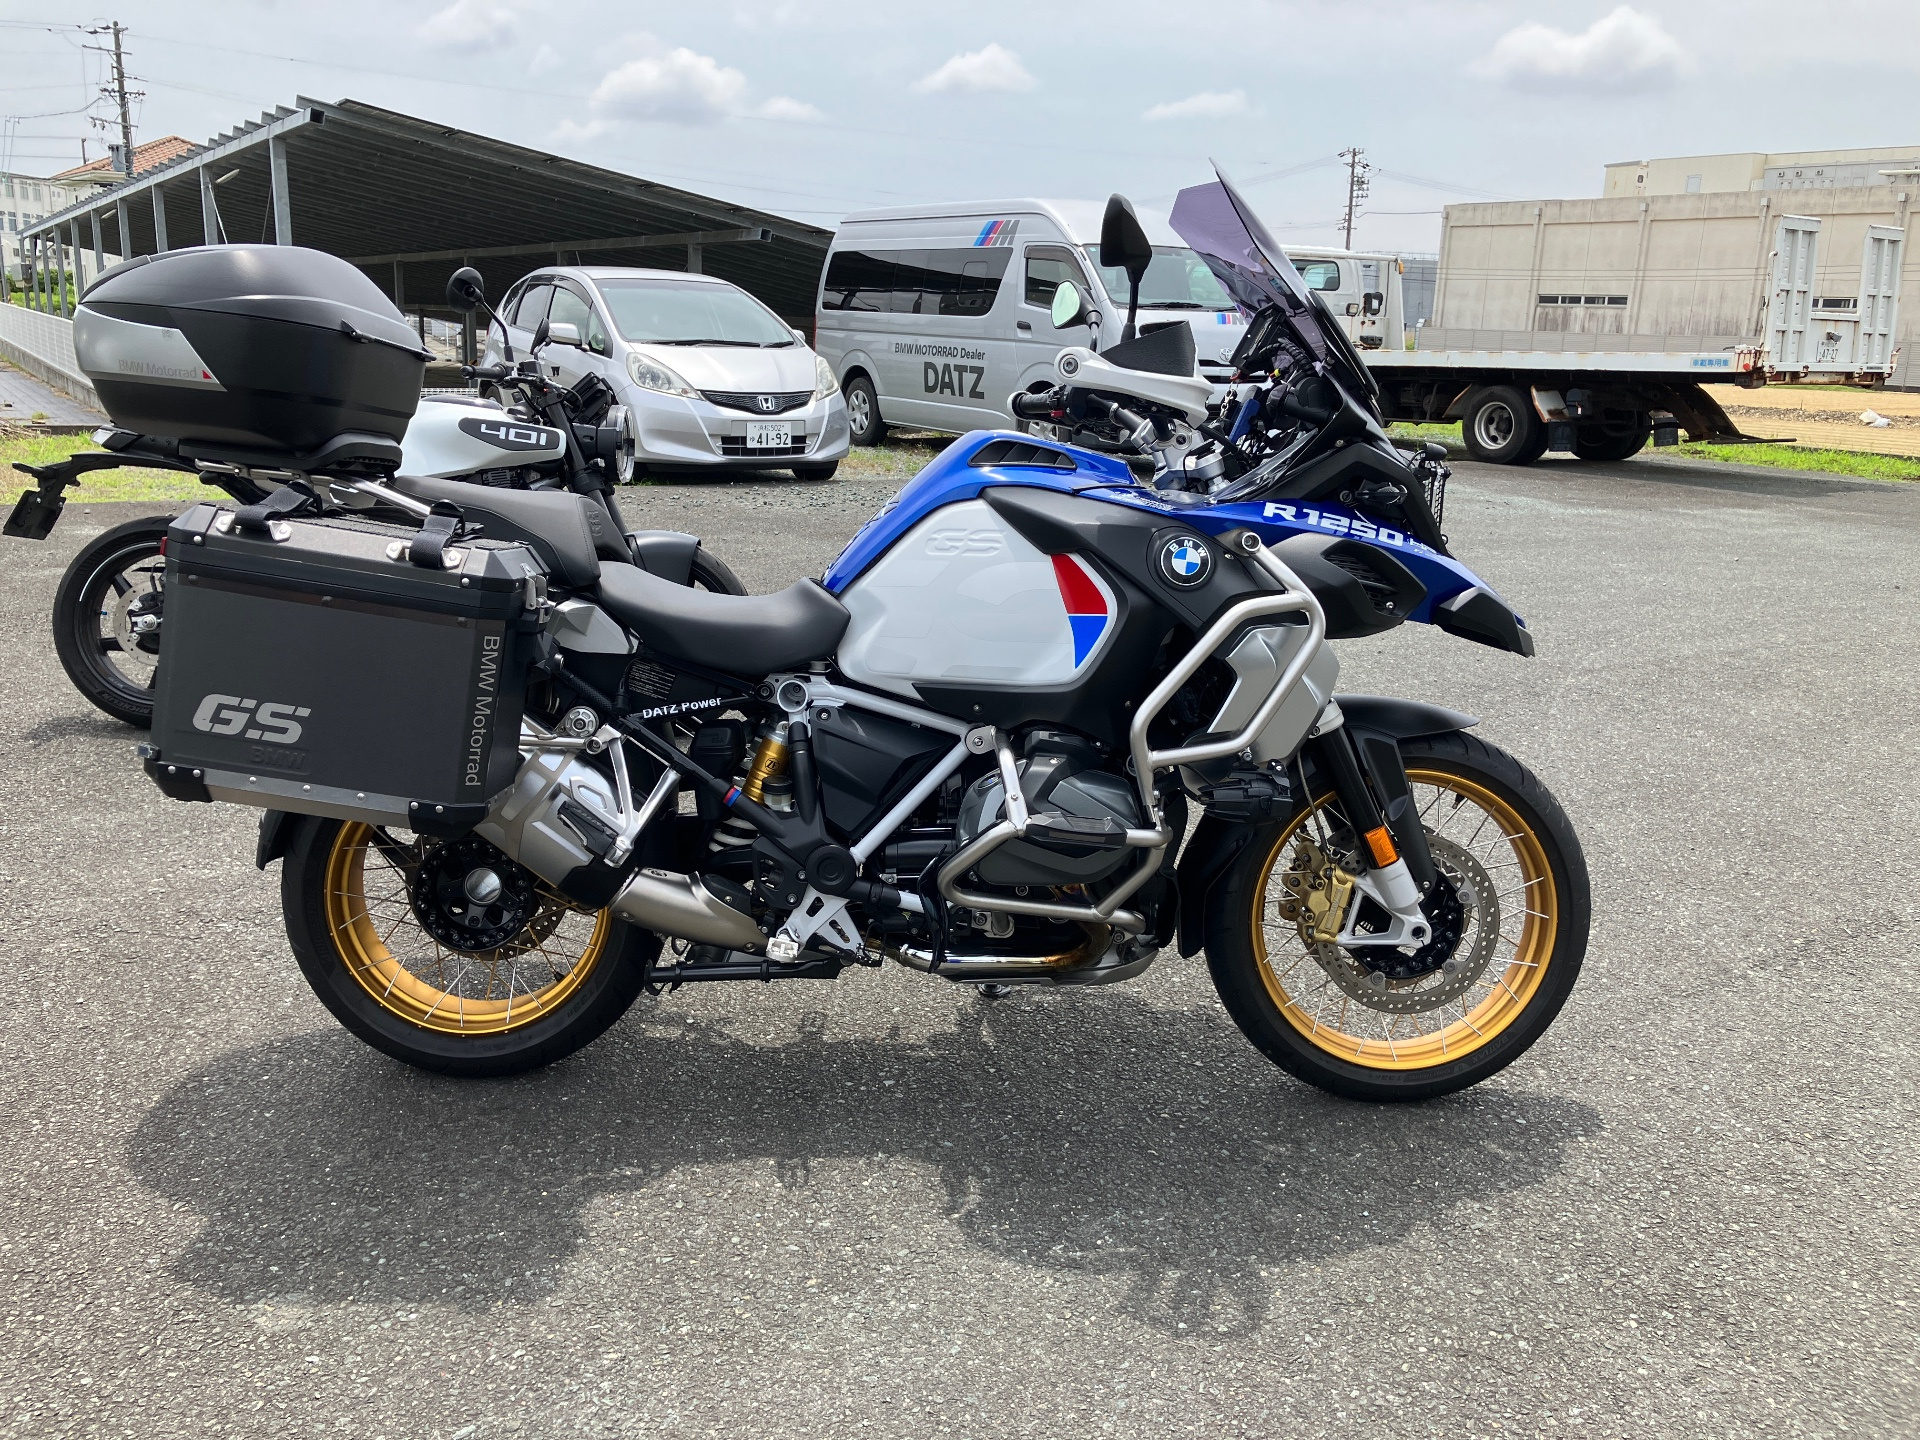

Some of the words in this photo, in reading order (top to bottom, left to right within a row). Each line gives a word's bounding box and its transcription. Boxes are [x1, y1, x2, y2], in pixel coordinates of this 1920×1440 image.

[894, 342, 914, 354] BMW
[914, 344, 959, 358] MOTORRAD
[960, 347, 985, 360] Dealer
[118, 359, 144, 373] BMW
[146, 363, 197, 379] Motorrad
[923, 361, 985, 400] DATZ
[480, 423, 547, 446] 401
[756, 432, 789, 446] 41-92
[1302, 508, 1404, 546] 1250
[924, 528, 1008, 557] GS
[1168, 539, 1208, 557] BMW
[478, 635, 501, 692] BMW
[192, 693, 312, 744] GS
[642, 704, 679, 719] DATZ
[681, 697, 722, 712] Power
[465, 696, 493, 786] Motorrad
